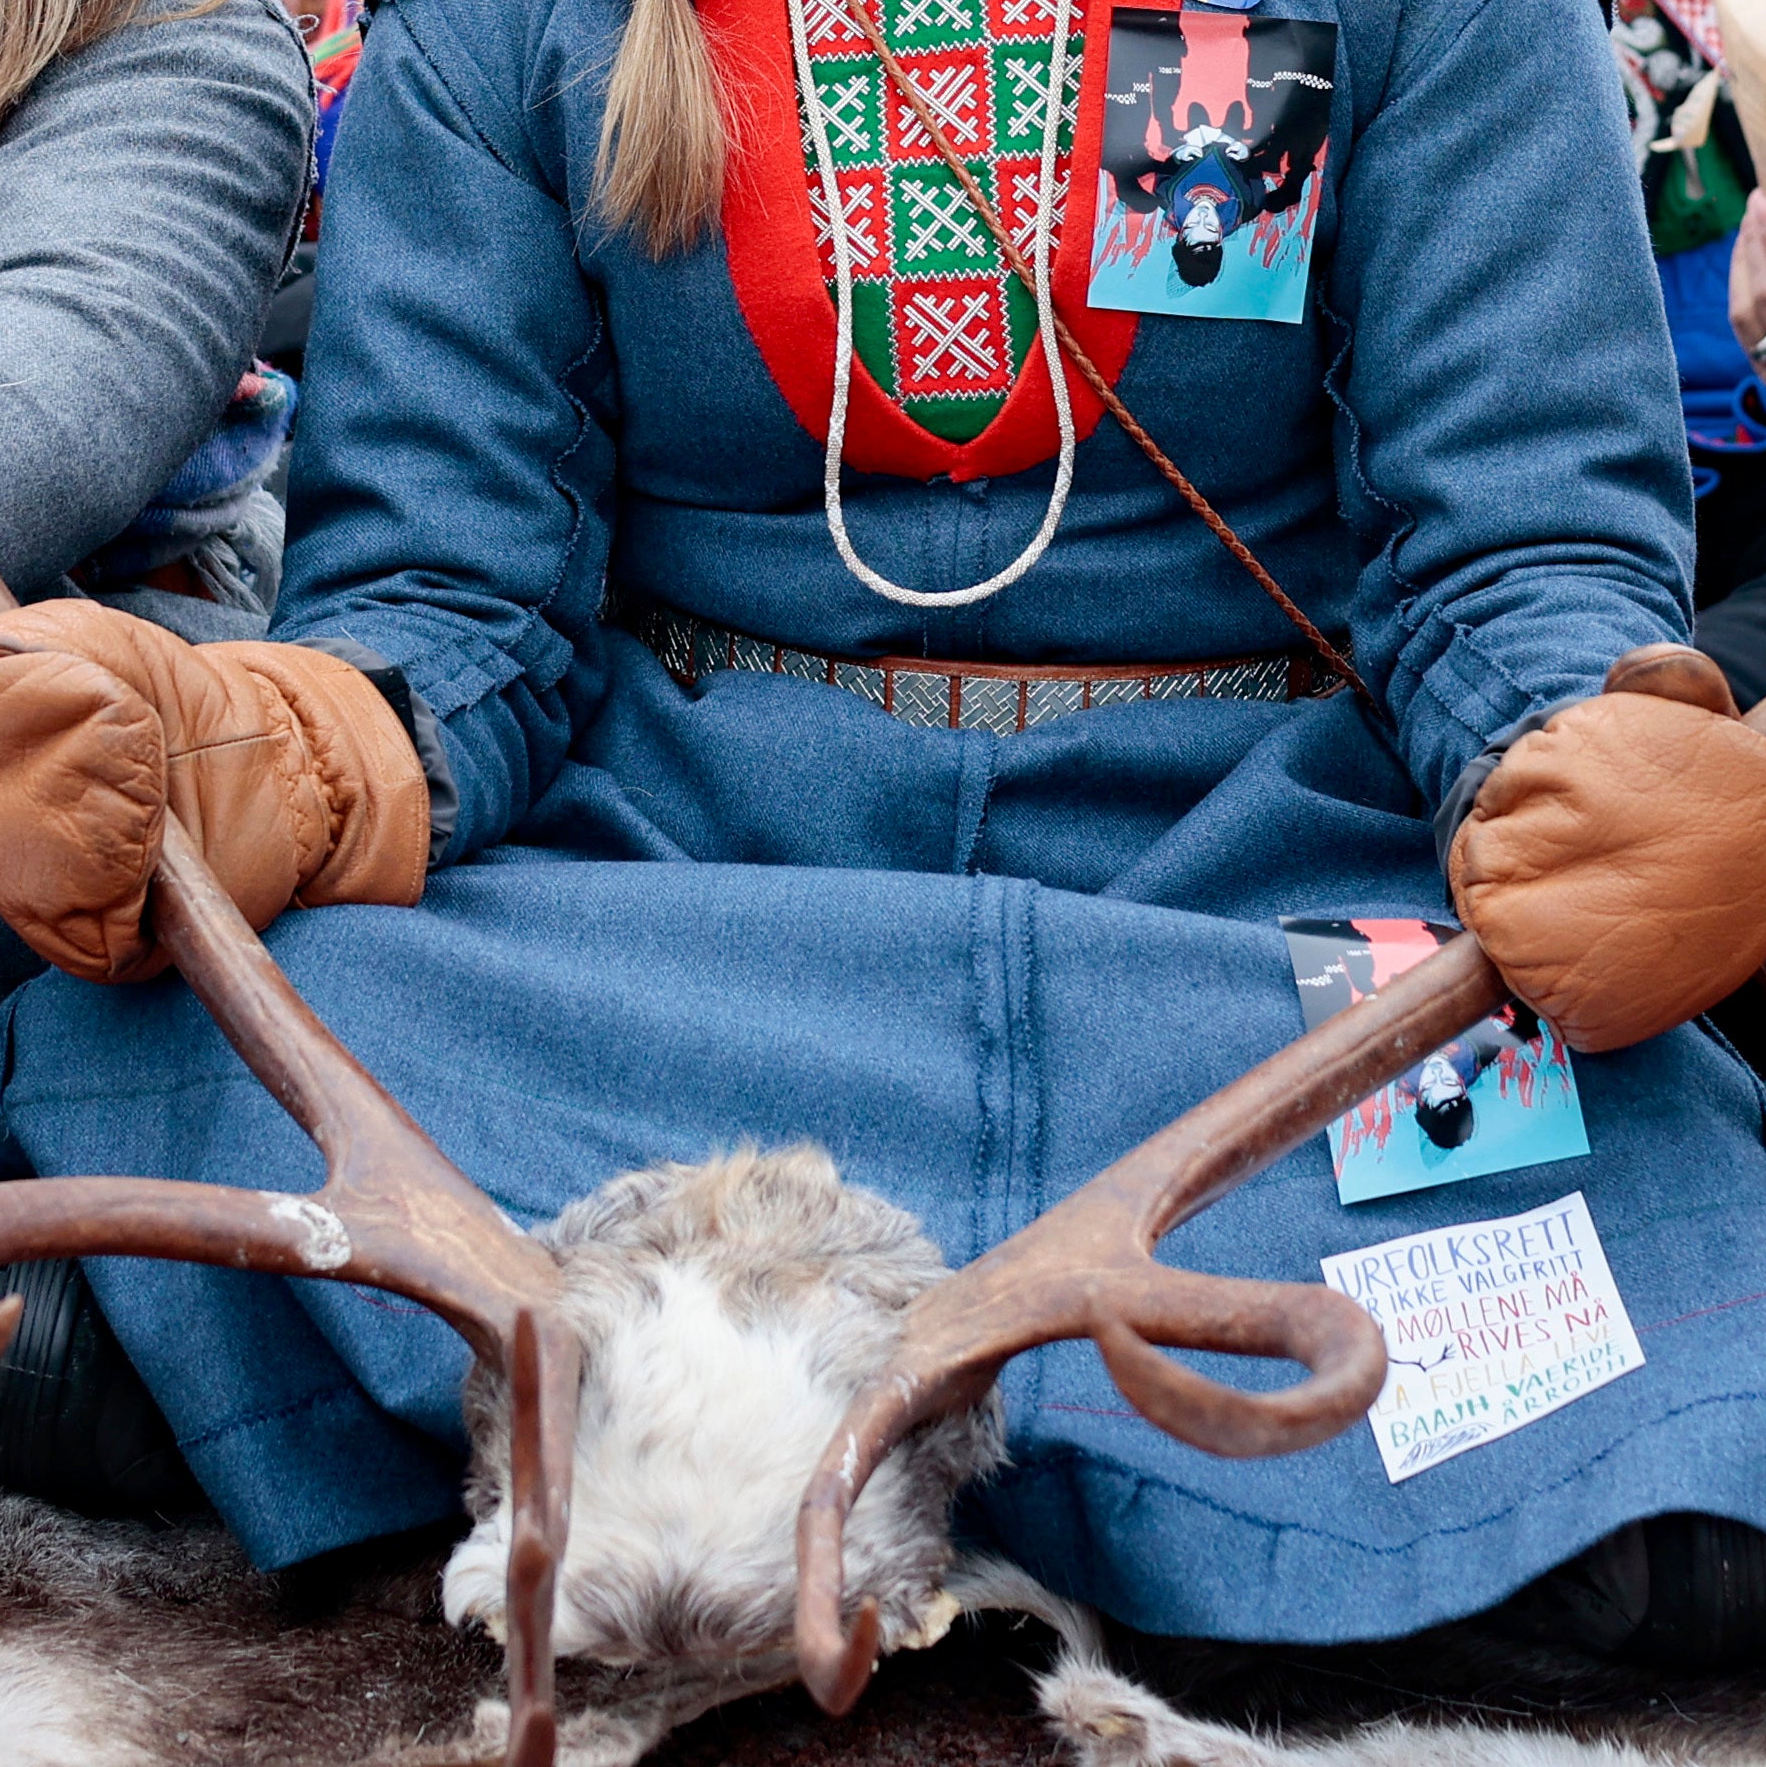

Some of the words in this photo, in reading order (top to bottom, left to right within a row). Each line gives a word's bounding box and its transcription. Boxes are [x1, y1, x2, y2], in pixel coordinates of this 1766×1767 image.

[1336, 1209, 1575, 1301] URFOLKSRETT
[1389, 1280, 1449, 1315] IKKE
[1458, 1249, 1584, 1295] VALGFRITT
[1544, 1270, 1590, 1310] MÅ
[1455, 1318, 1552, 1361] RIVES
[1564, 1297, 1610, 1334] NÅ
[1429, 1353, 1535, 1402] FJELLA
